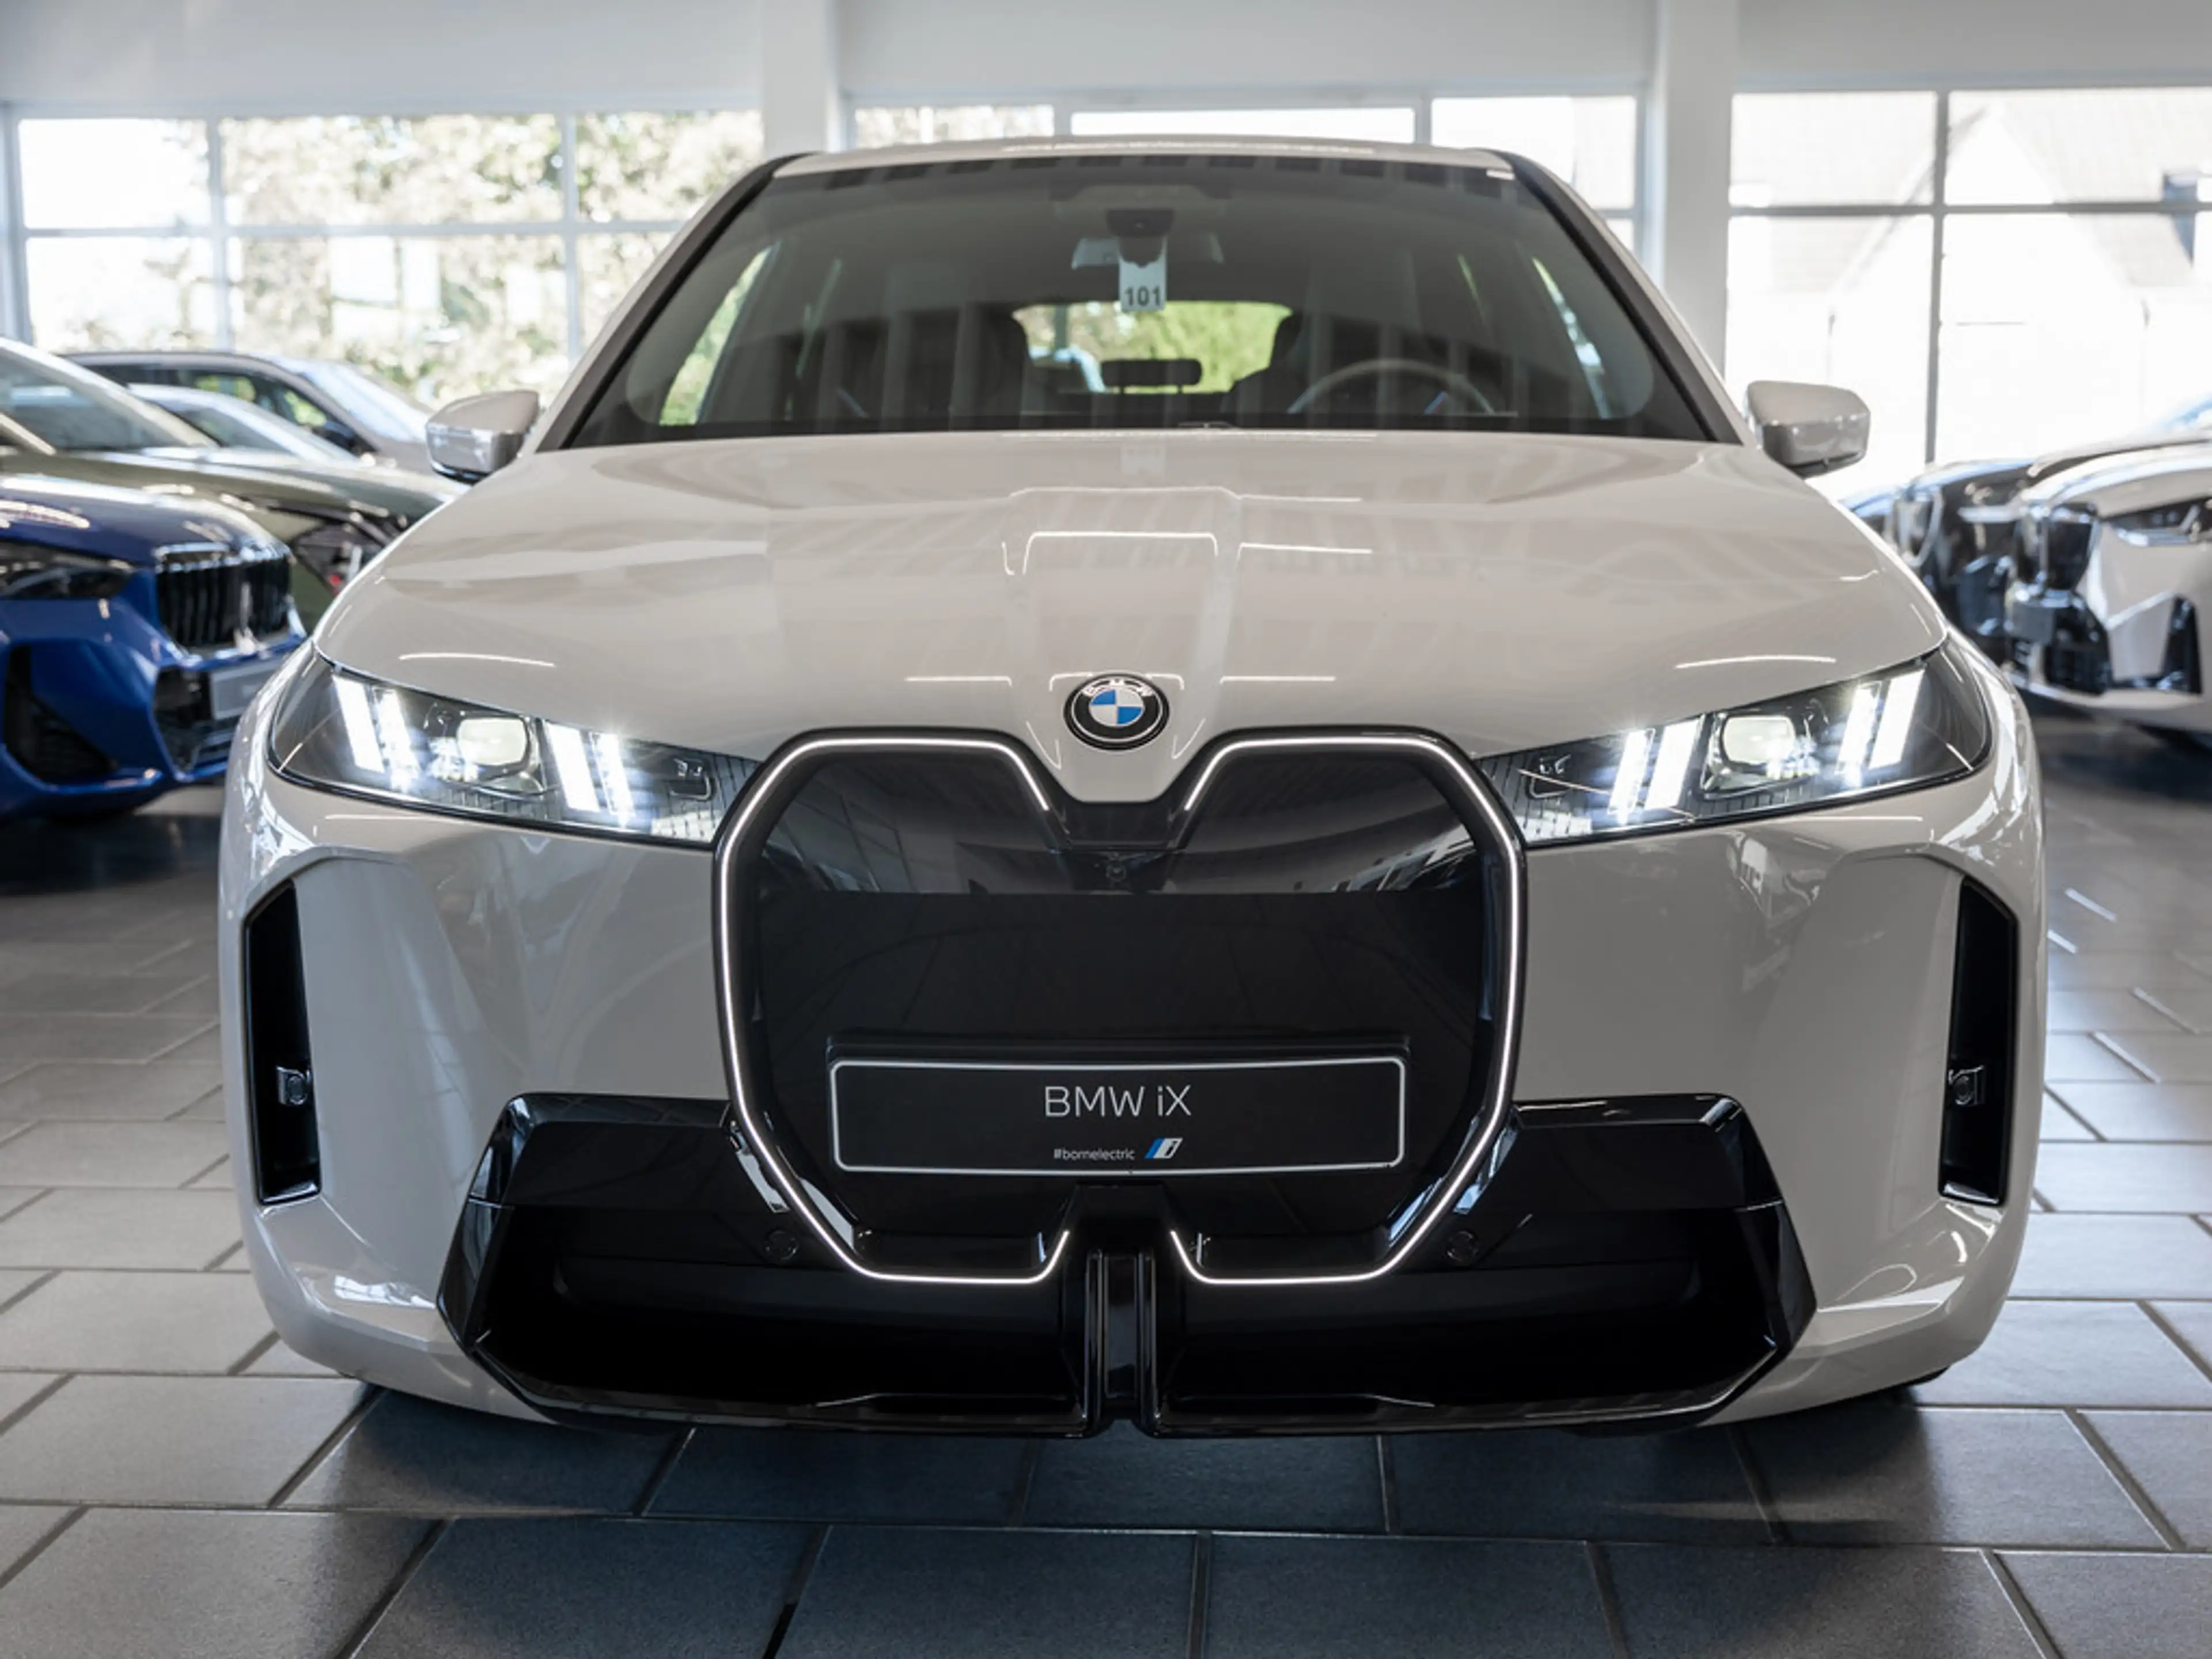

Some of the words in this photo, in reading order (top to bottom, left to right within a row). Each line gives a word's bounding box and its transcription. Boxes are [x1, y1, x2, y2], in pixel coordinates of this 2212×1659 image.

[1124, 286, 1161, 306] 101
[1044, 1085, 1145, 1118] BMW
[1157, 1085, 1192, 1117] iX
